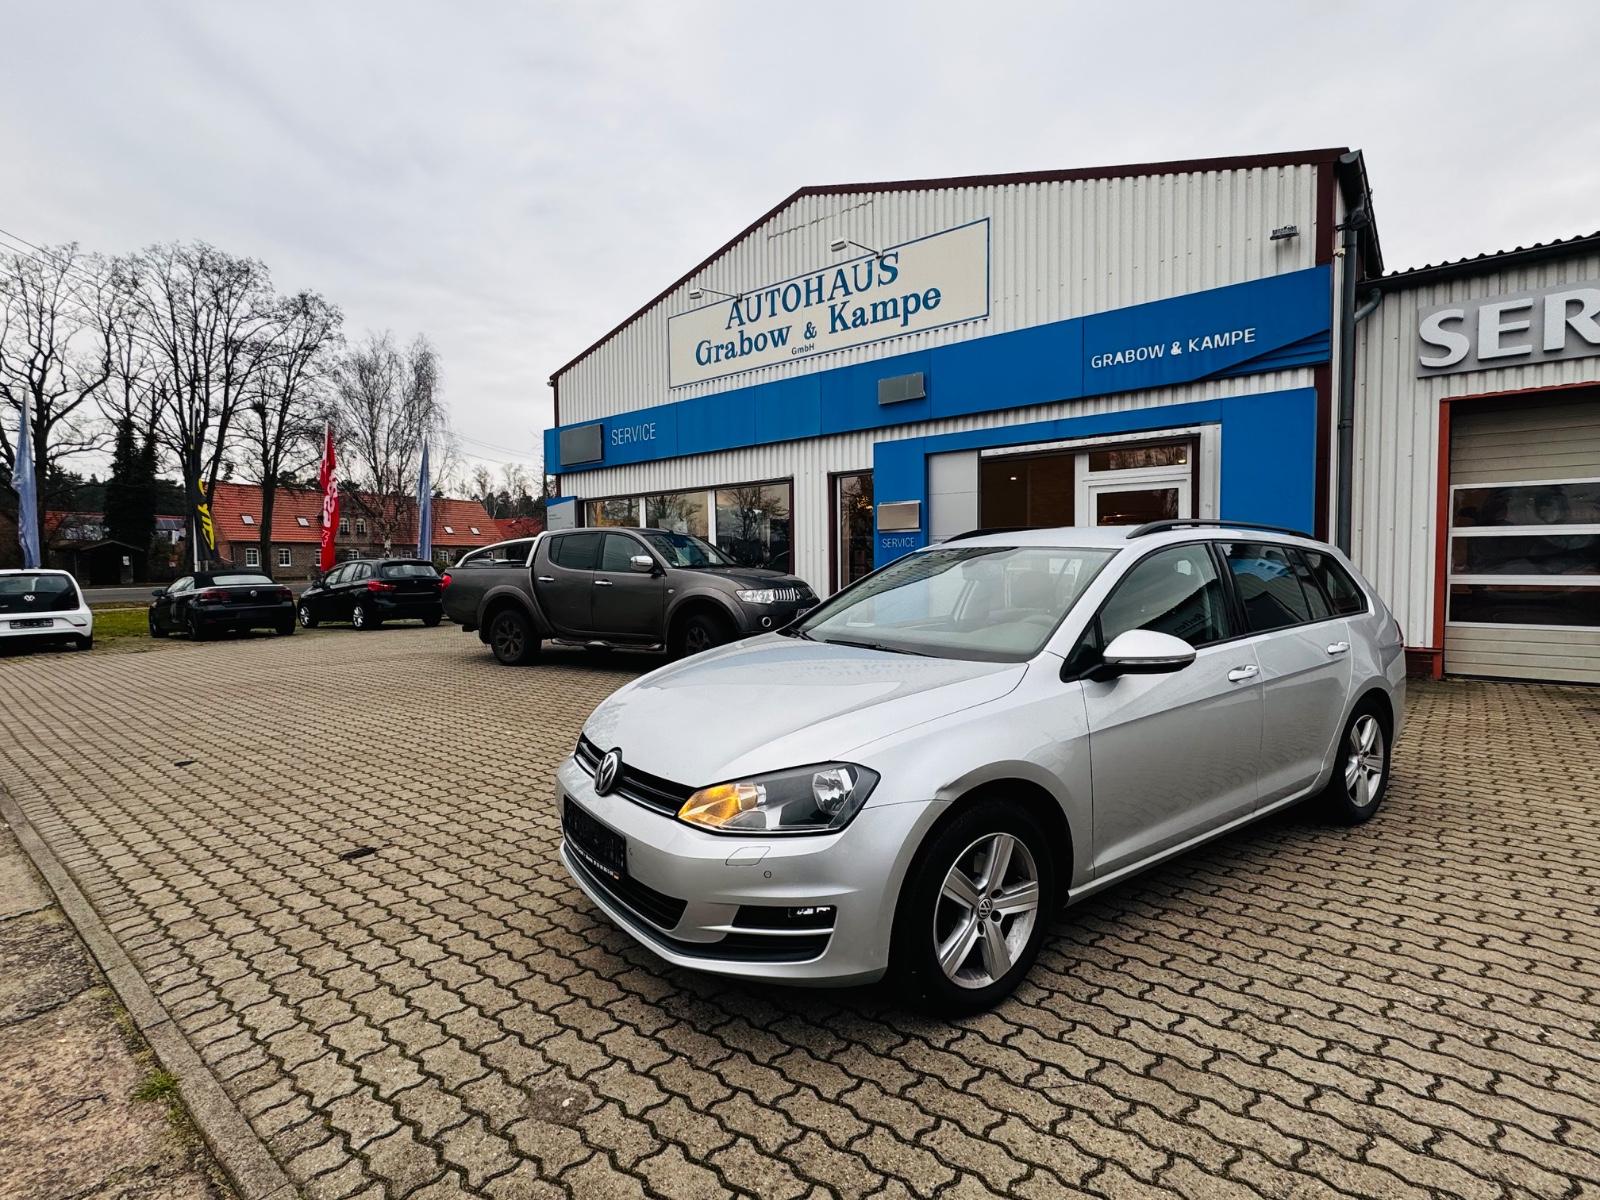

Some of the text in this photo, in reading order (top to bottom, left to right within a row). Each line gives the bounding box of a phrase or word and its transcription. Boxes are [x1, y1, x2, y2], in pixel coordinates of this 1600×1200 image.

[724, 251, 899, 330] AUTOHAUS
[695, 287, 942, 366] Grabow & Kampe
[1419, 288, 1600, 368] SER
[791, 344, 815, 355] GmbH
[1091, 327, 1256, 369] GRABOW & KAMPE
[611, 422, 656, 446] SERVICE
[882, 537, 915, 548] SERVICE
